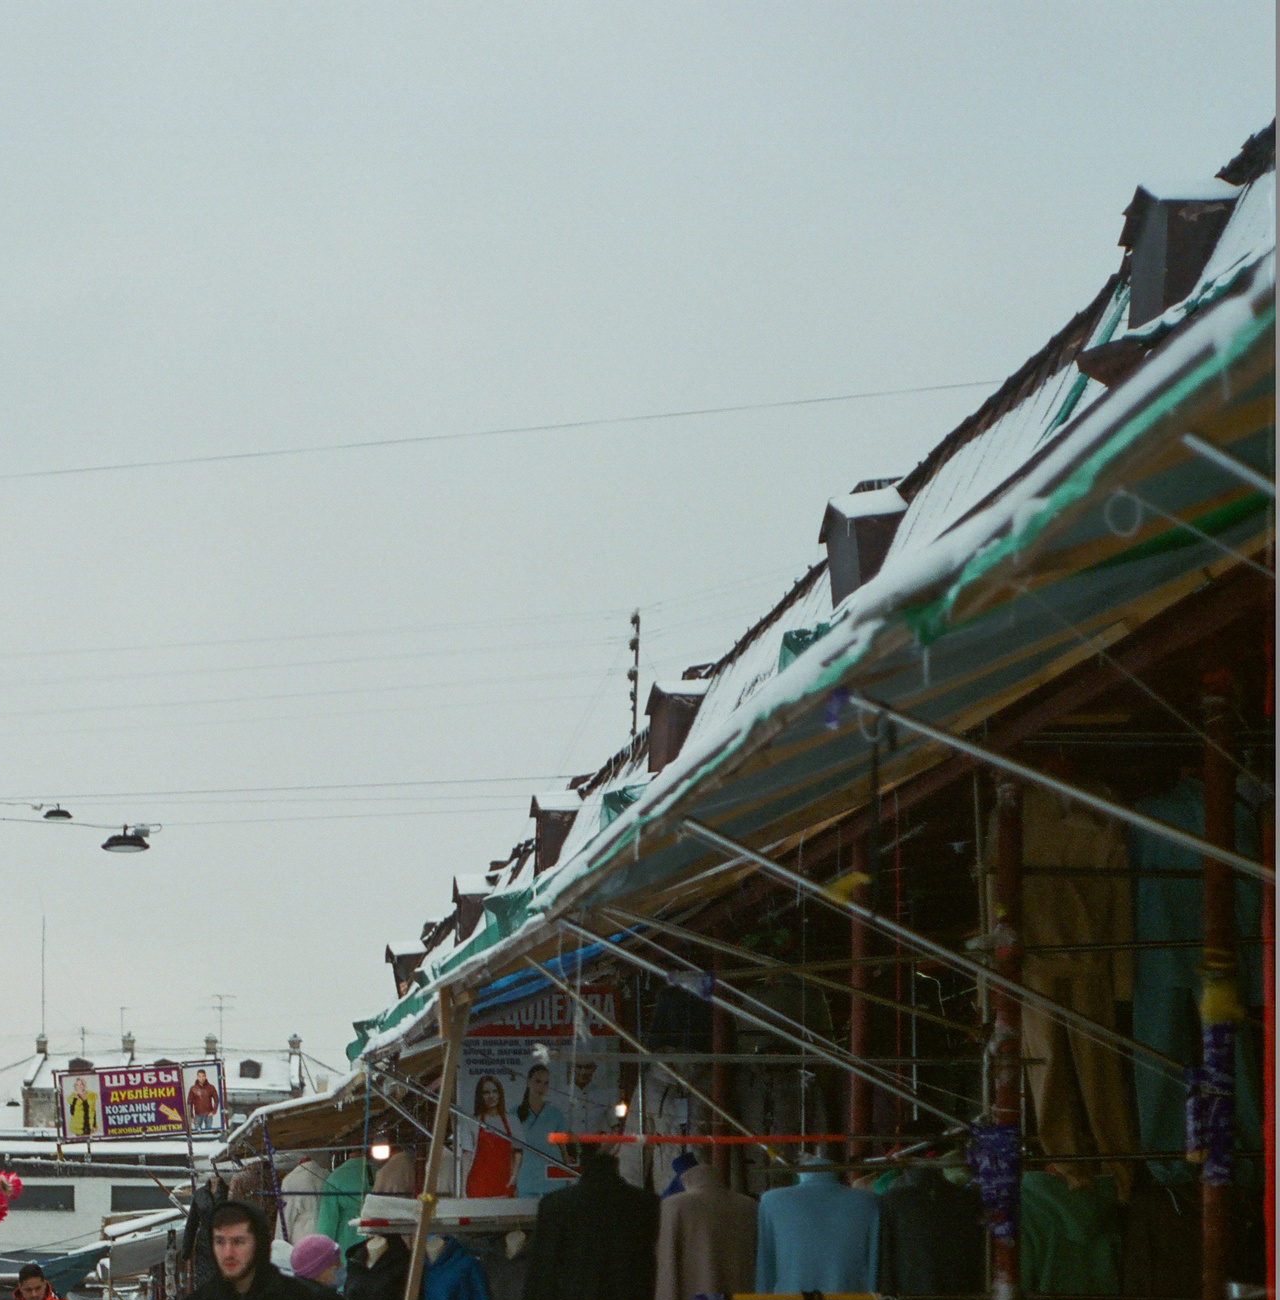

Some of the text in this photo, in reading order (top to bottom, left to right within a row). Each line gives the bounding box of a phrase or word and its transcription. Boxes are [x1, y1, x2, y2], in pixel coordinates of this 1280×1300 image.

[104, 1070, 179, 1087] ШУБЫ
[110, 1086, 176, 1103] ДУБЛЁНКИ
[105, 1102, 156, 1115] КОЖАНЫЕ
[108, 1112, 156, 1126] КУРТКИ
[107, 1123, 183, 1135] МЕХОВЫЕ ЖИЛЕТКИ
